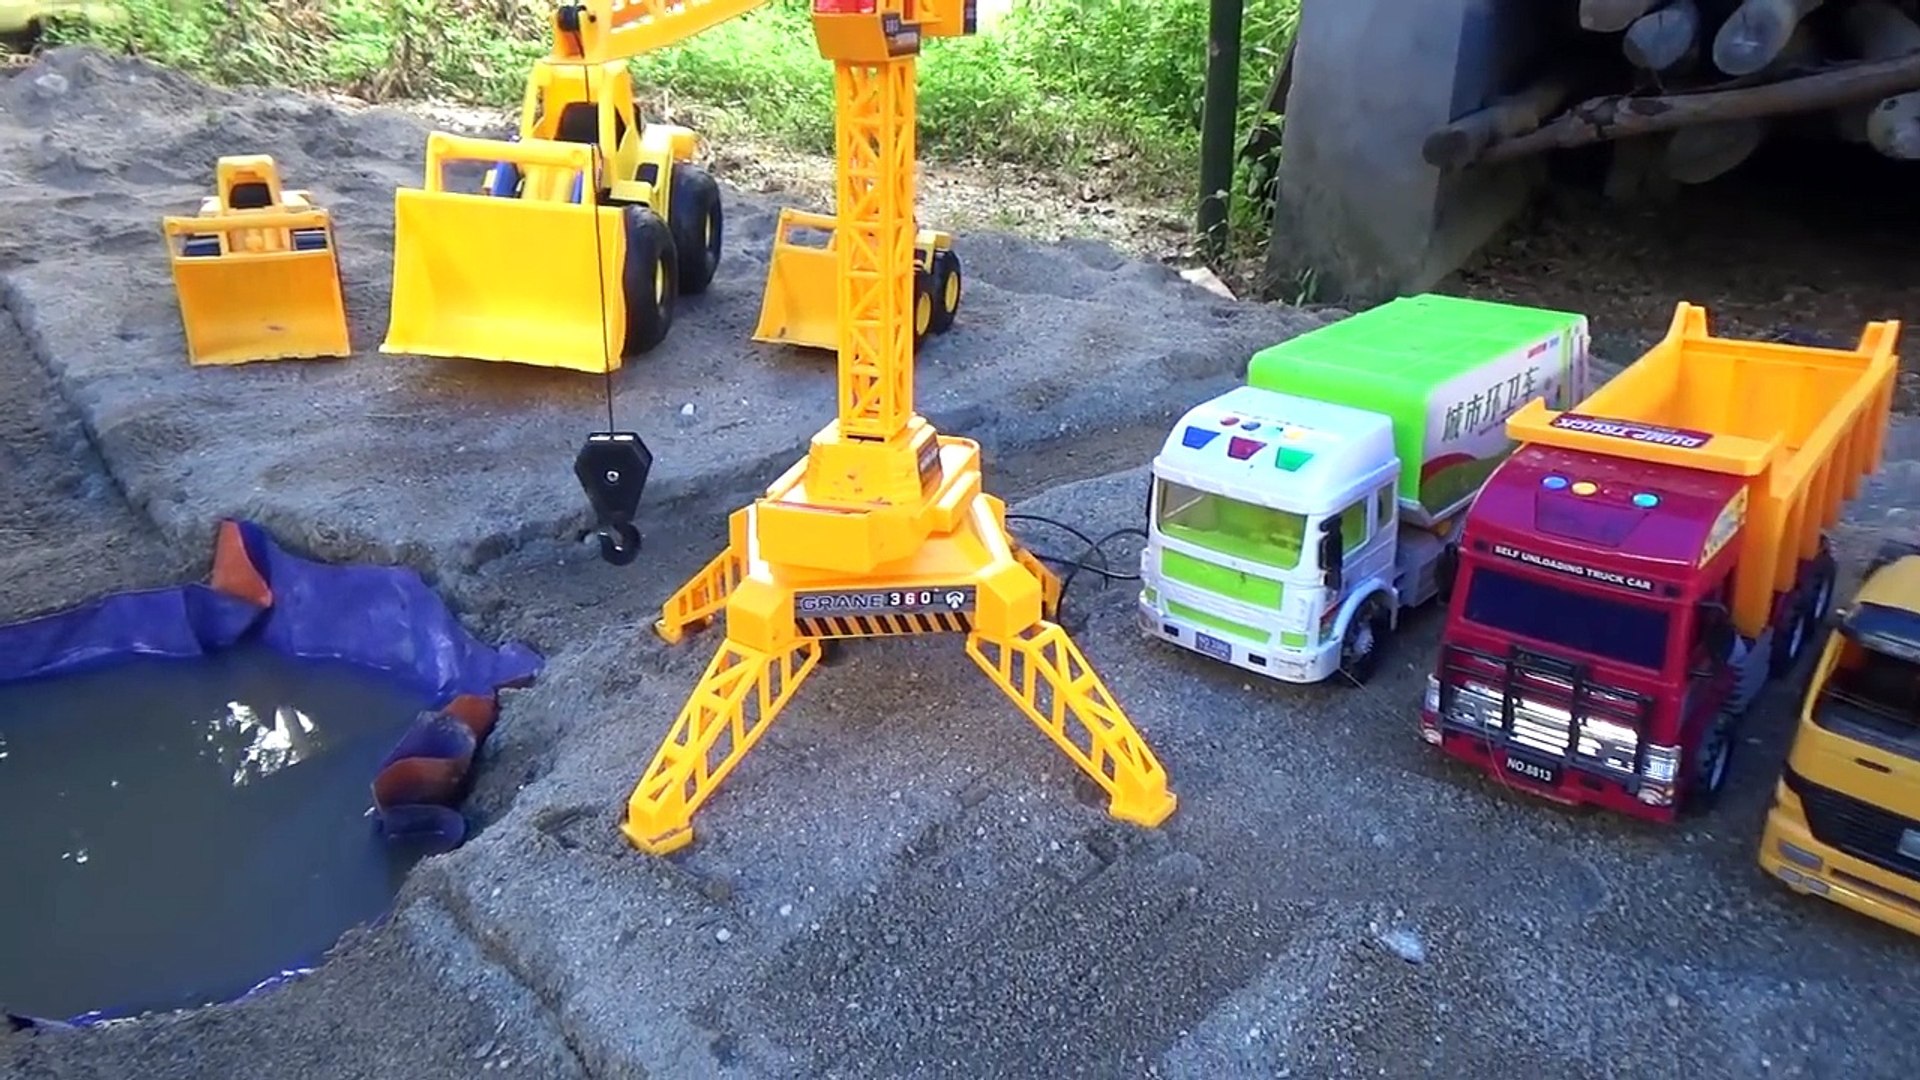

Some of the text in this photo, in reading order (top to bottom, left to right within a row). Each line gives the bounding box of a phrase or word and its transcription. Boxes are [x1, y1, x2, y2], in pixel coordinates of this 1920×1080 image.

[1442, 366, 1540, 442] 城市环卫车
[1557, 417, 1704, 448] DUMP TRUCK
[1494, 545, 1652, 591] SELF UNLOADING TRUCK CAR
